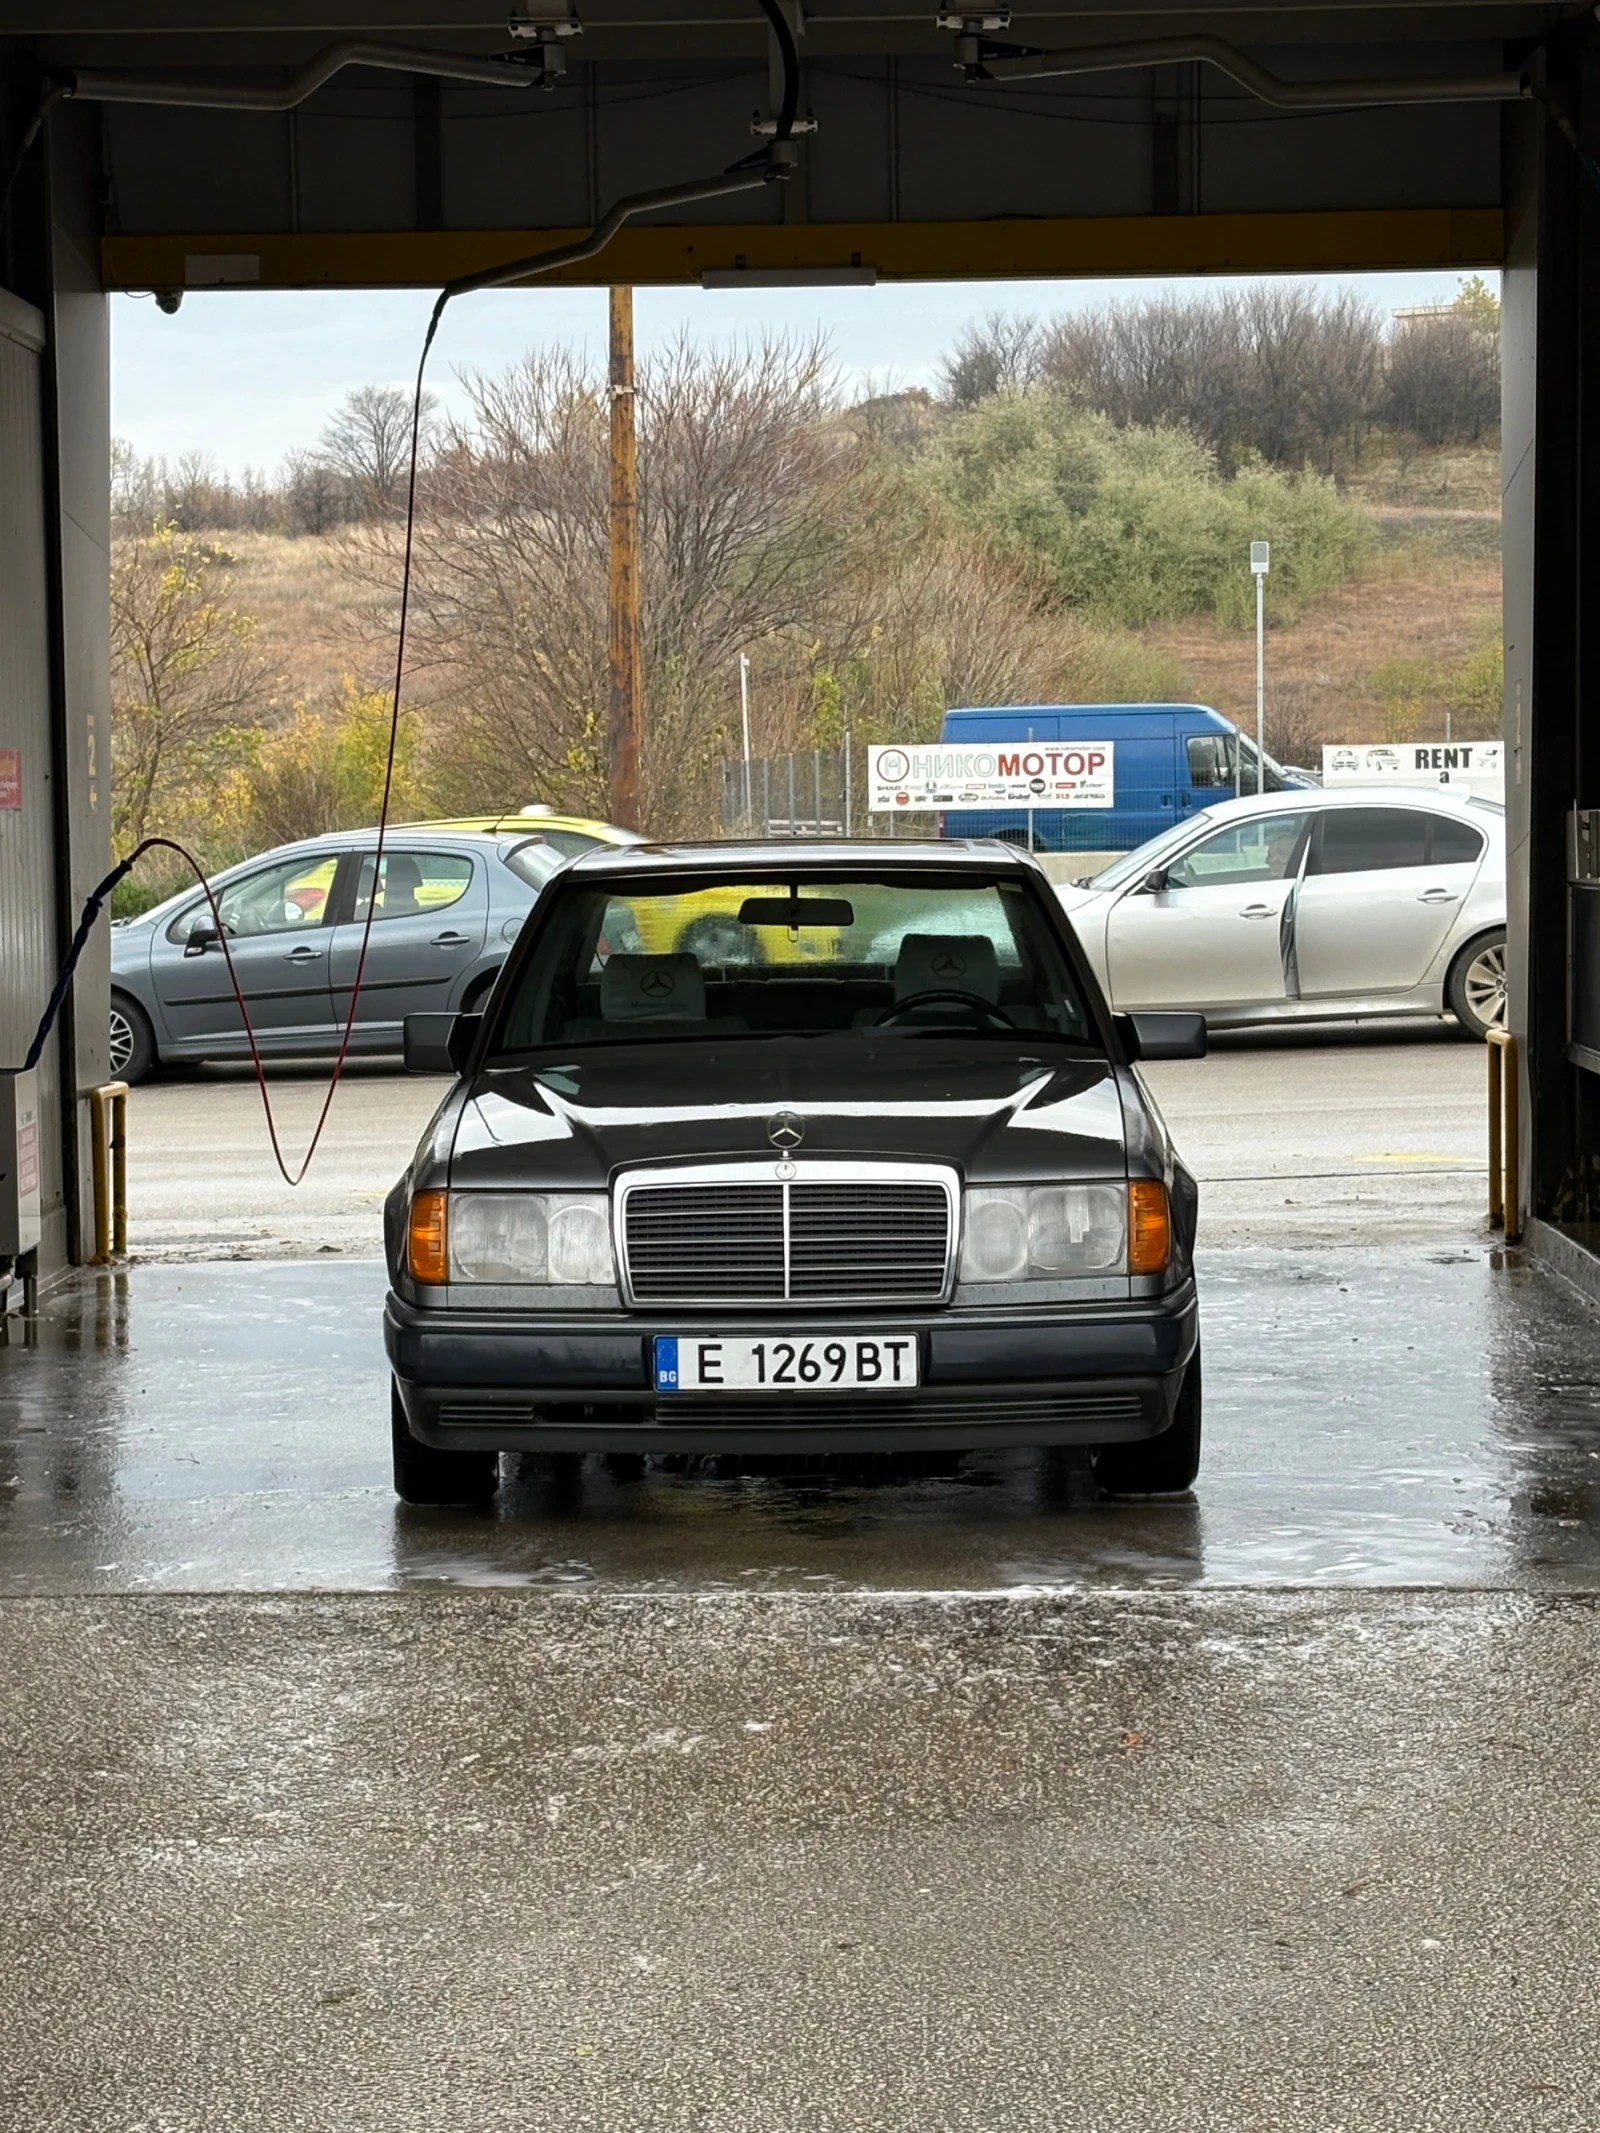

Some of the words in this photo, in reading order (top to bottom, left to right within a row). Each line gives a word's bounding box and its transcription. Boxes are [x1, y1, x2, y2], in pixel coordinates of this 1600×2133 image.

[1414, 747, 1473, 770] RENT
[1439, 771, 1450, 784] a
[698, 1344, 724, 1383] E
[659, 1371, 677, 1382] BG
